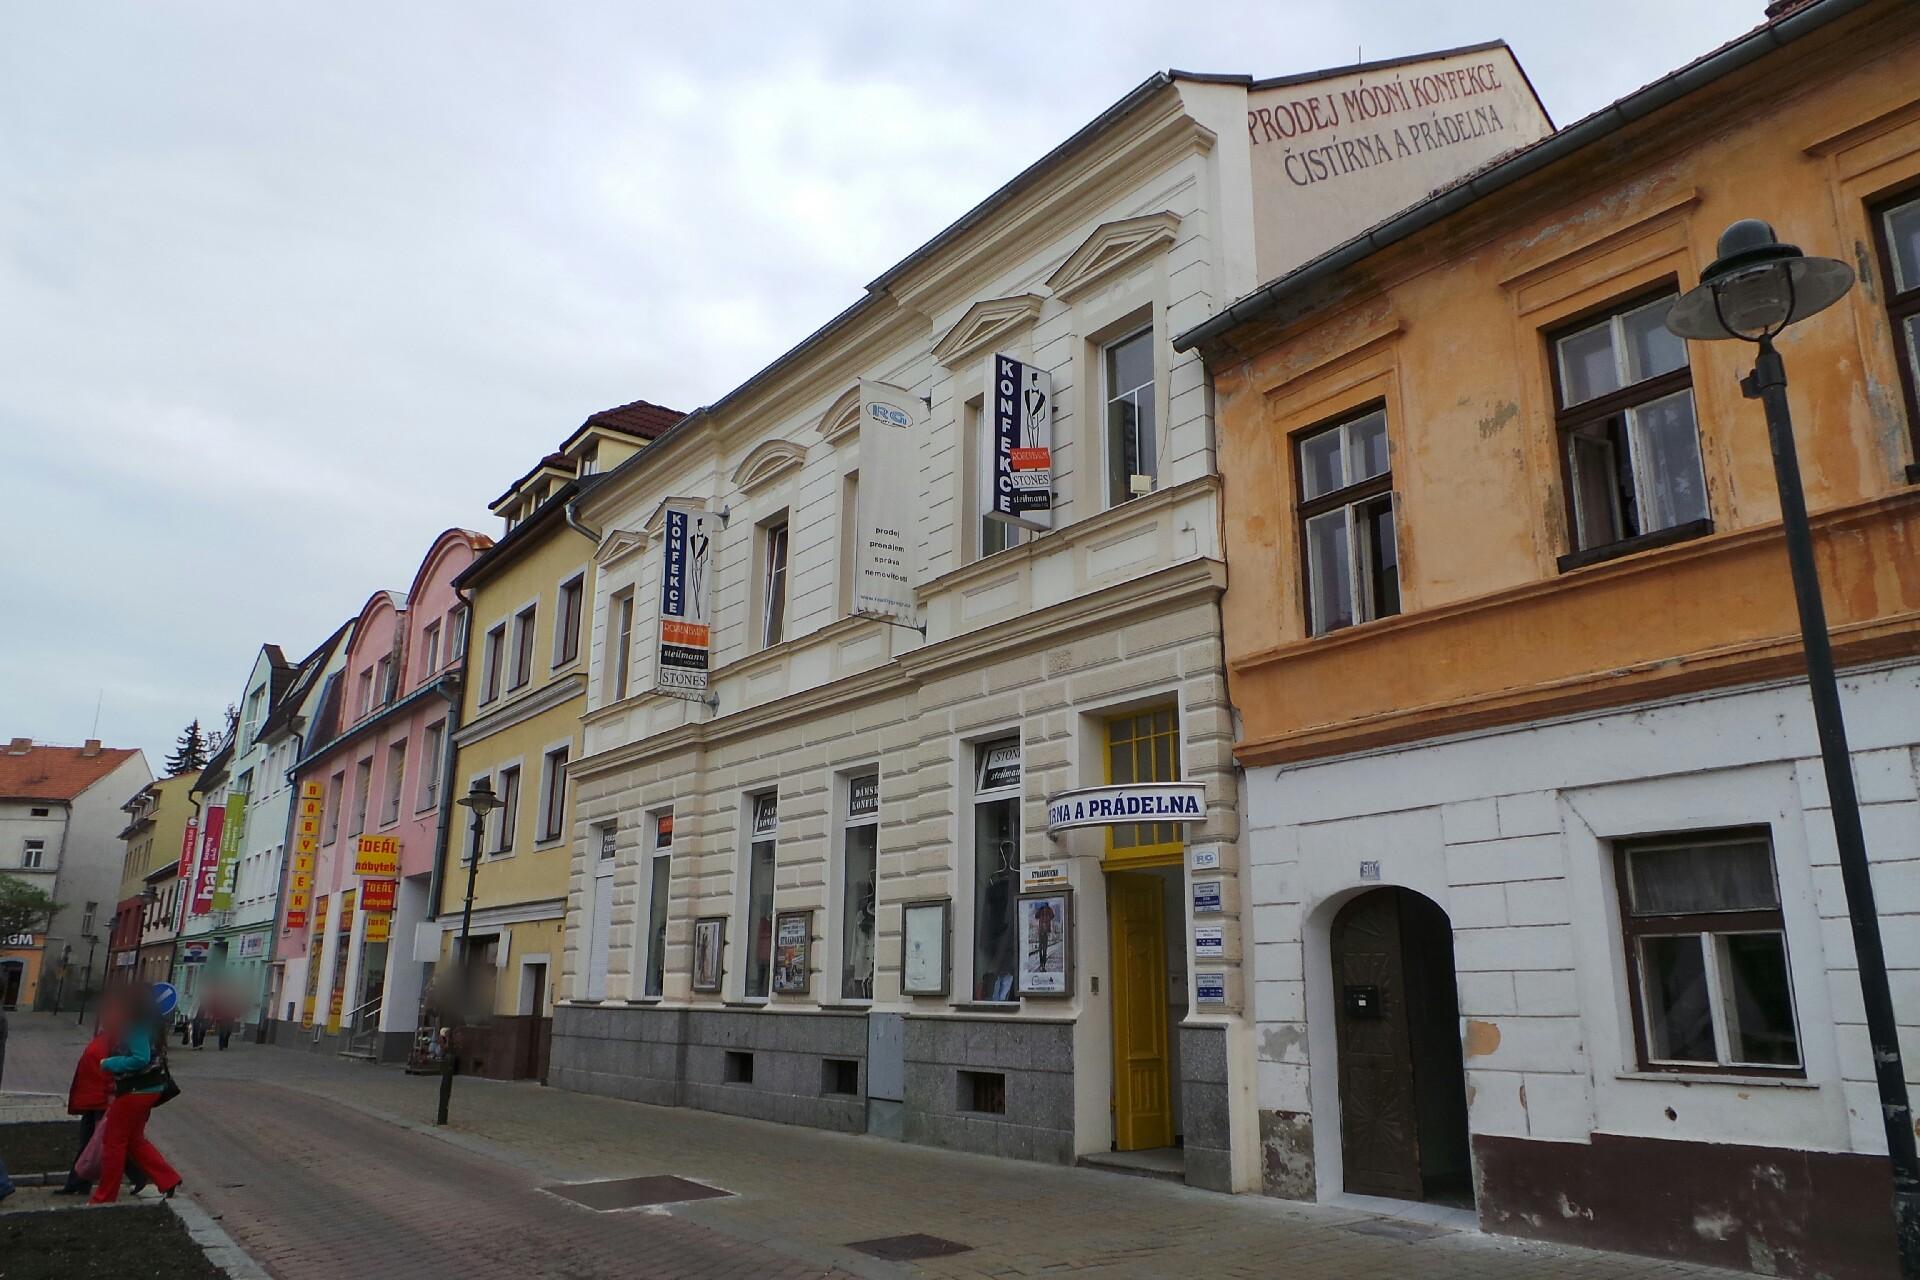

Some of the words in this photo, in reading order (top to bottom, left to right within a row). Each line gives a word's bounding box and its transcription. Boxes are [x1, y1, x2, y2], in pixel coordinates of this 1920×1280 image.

[1248, 94, 1339, 145] PRODEJ
[1342, 73, 1411, 124] MÓDNÍ
[1410, 63, 1502, 108] KONFEKCE
[1284, 134, 1393, 187] ČISTÍRNA
[1394, 128, 1411, 159] A
[1408, 104, 1504, 154] PRÁDELNA
[1000, 360, 1014, 513] KONFEKCE
[1013, 474, 1049, 486] STONES
[875, 527, 900, 539] prodej
[669, 514, 682, 613] KONFEKCE
[874, 556, 900, 566] správa
[865, 569, 908, 583] nemovitosti
[664, 649, 705, 662] steilmann
[663, 672, 706, 687] STONES
[1075, 802, 1085, 820] A
[1089, 792, 1200, 818] PRÁDELNA
[198, 866, 218, 900] hai
